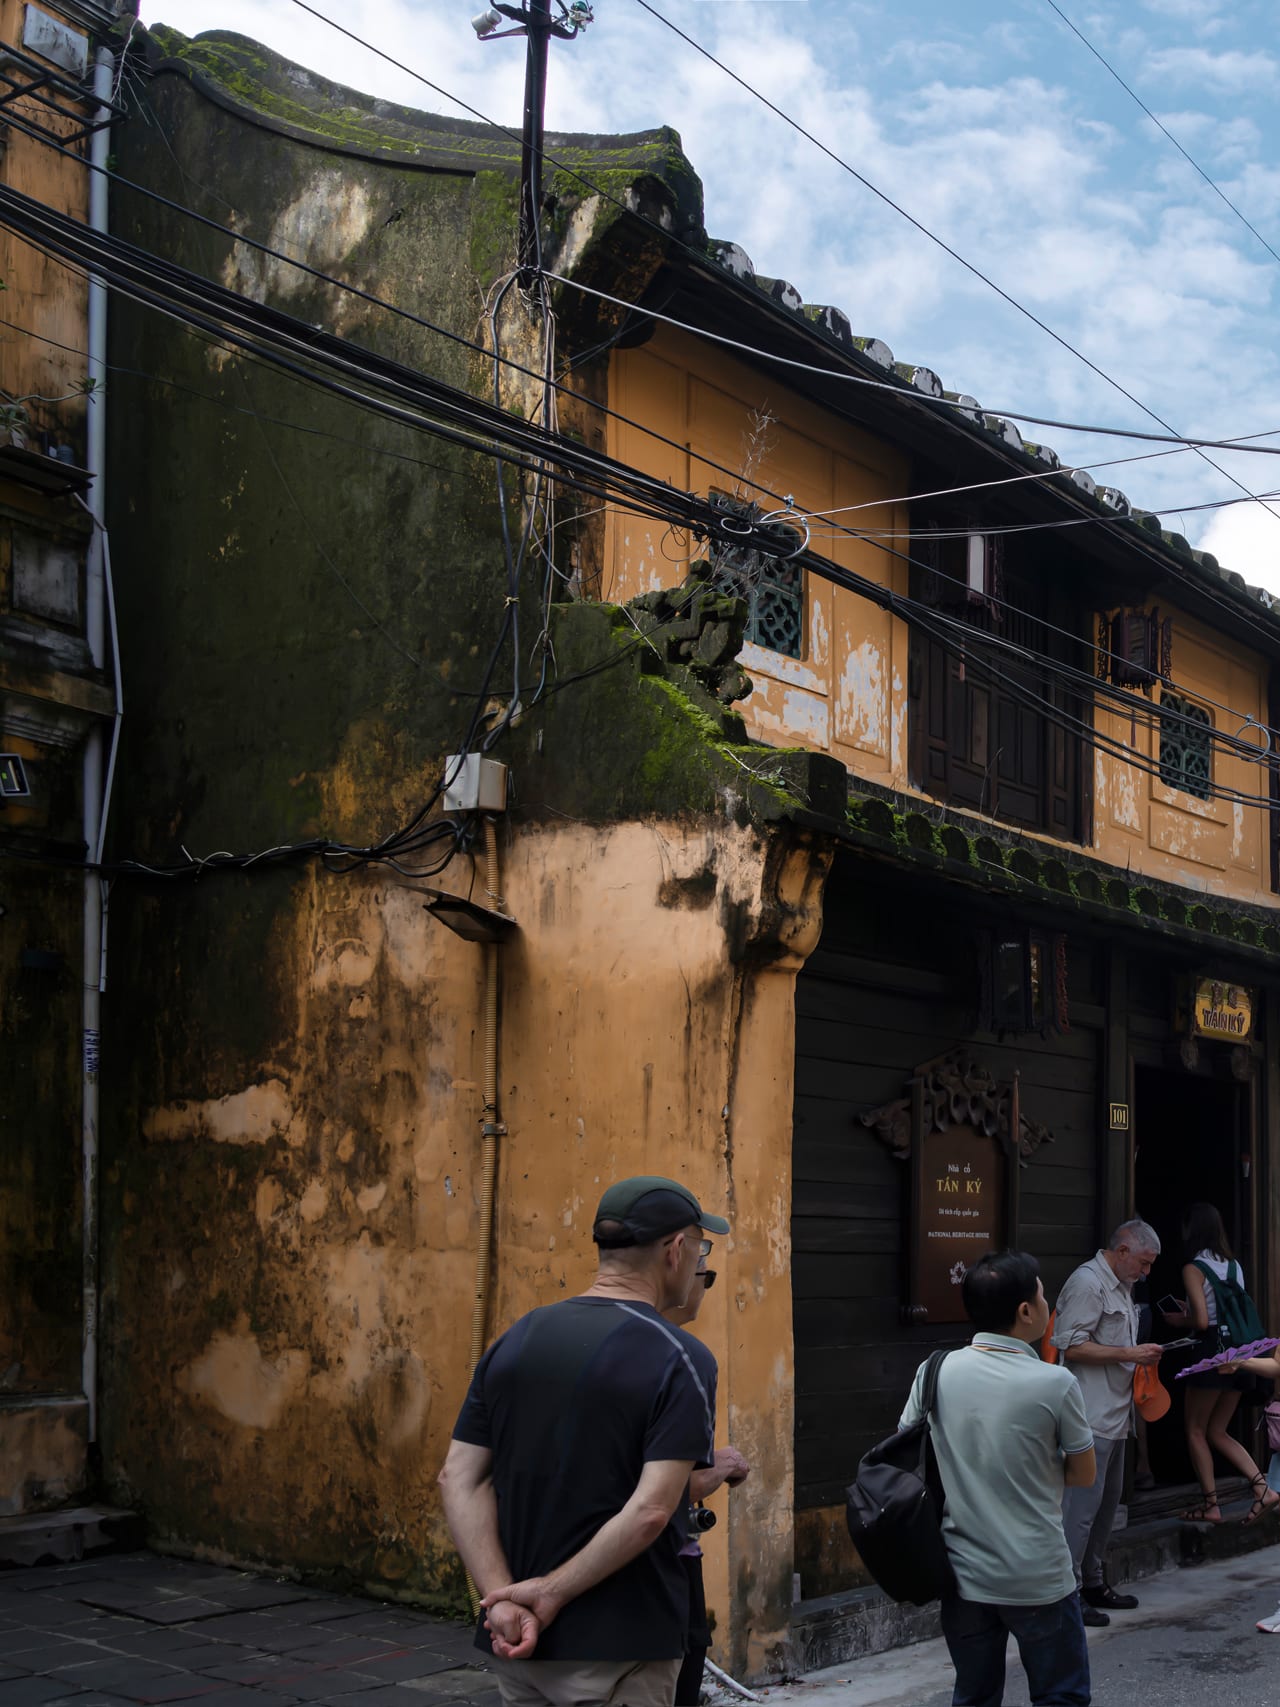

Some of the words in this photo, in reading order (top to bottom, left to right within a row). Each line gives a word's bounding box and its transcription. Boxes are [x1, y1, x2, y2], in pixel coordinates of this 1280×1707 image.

[1113, 1109, 1126, 1124] 101
[928, 1231, 951, 1239] NATIONAL
[951, 1231, 974, 1239] HERITAGE
